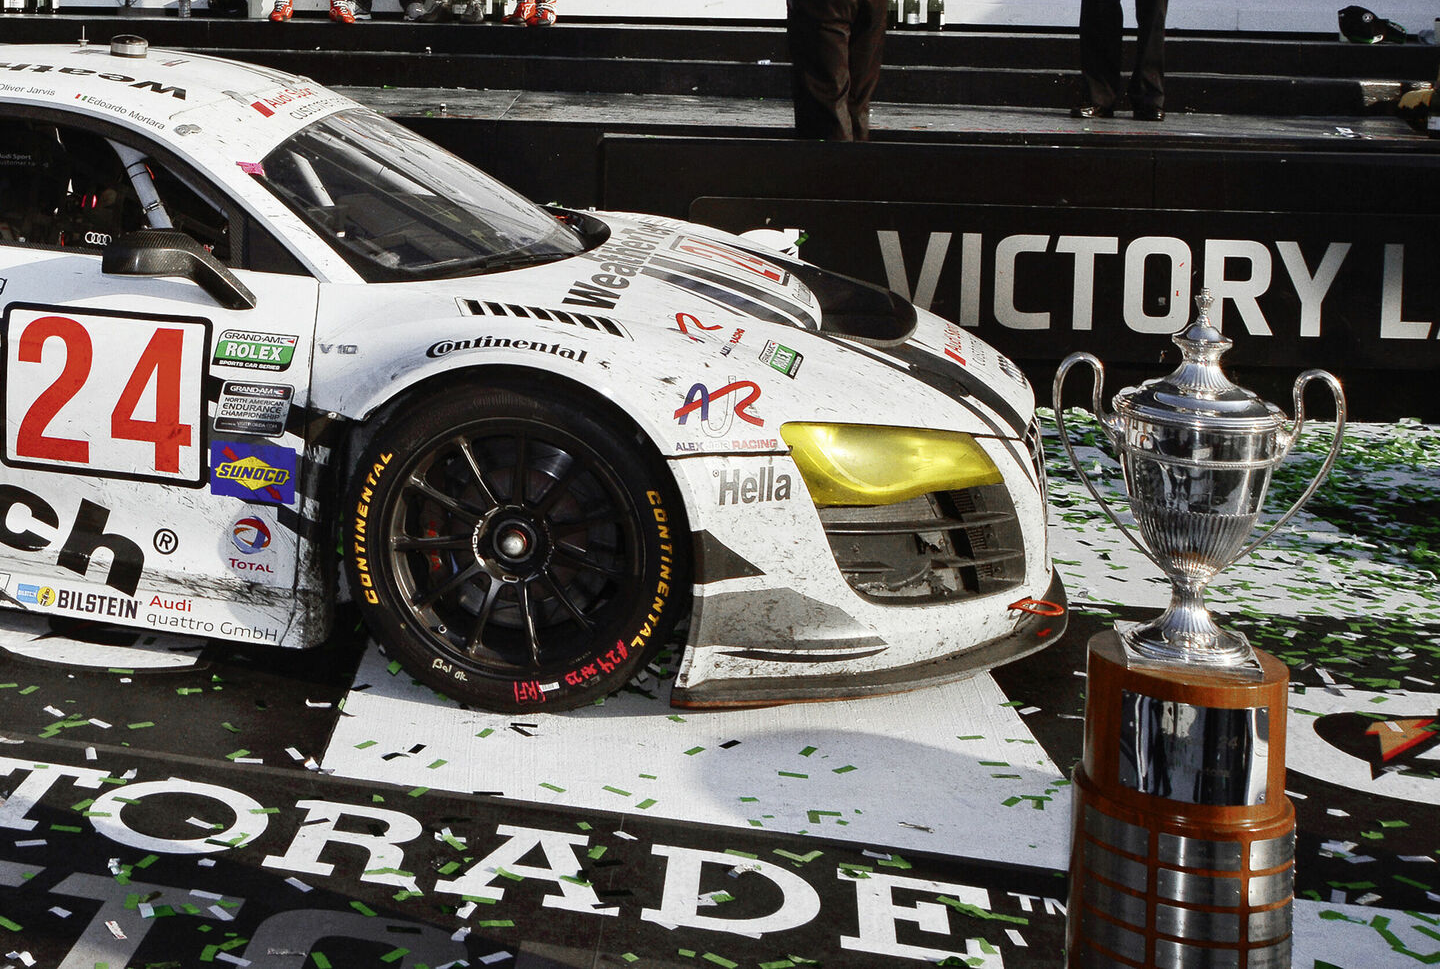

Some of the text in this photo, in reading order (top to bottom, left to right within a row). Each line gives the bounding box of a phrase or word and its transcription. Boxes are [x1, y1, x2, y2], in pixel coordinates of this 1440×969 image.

[27, 86, 56, 96] Jarvis
[87, 96, 165, 131] Edoardo Mortara
[877, 231, 1352, 338] VICTORY
[225, 343, 283, 361] ROLEX
[426, 335, 589, 364] Continental
[16, 316, 192, 474] 24
[222, 403, 282, 413] ENDURANCE
[221, 410, 280, 419] CHAMPIONSHIP
[676, 439, 778, 451] ALEX RACING
[218, 463, 288, 485] SUNOCO
[719, 466, 791, 505] Hella
[355, 451, 393, 605] CONTINENTAL
[228, 557, 274, 573] TOTAL
[630, 489, 673, 648] CONTINENTAL
[57, 589, 138, 619] BILSTEIN
[149, 595, 192, 613] Audi
[146, 613, 278, 642] quattro GmbH
